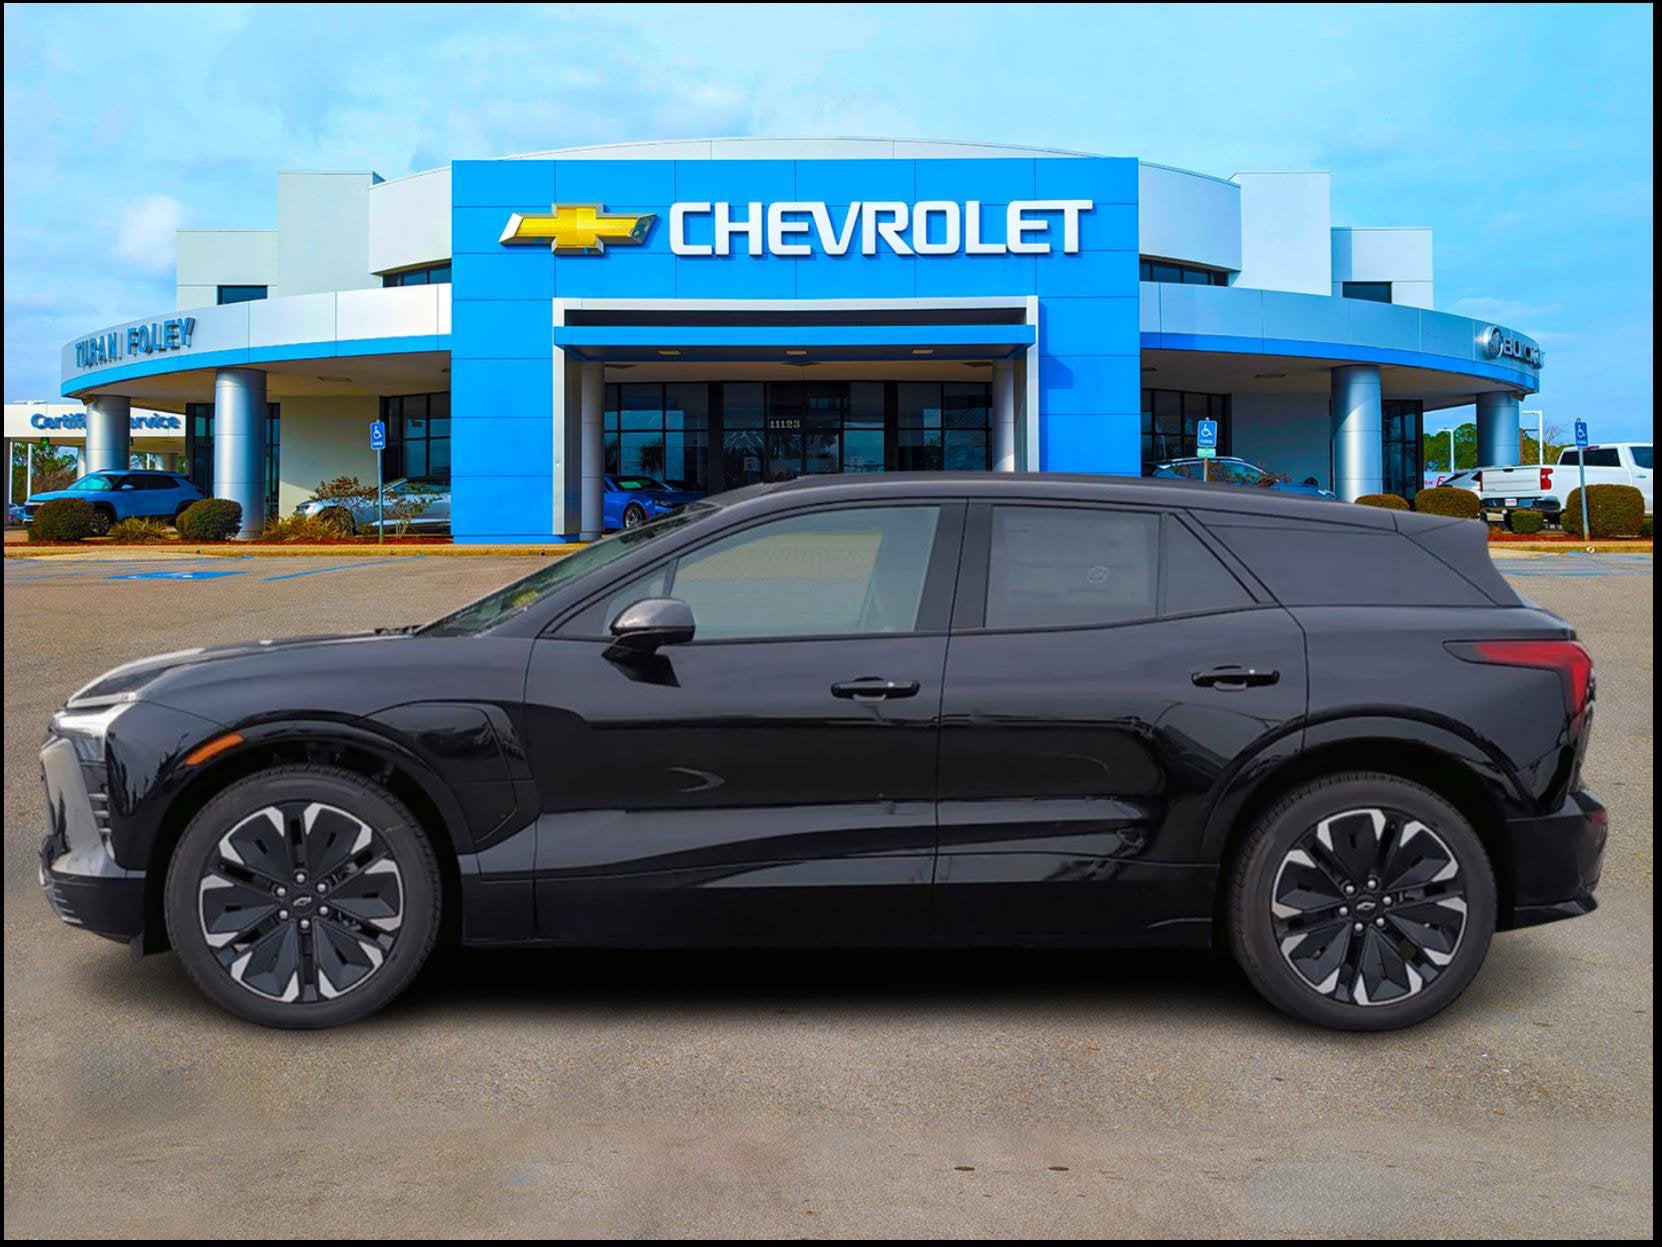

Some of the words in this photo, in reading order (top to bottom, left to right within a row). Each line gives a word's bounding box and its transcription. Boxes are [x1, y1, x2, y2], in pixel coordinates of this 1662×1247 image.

[669, 200, 1093, 256] CHEVROLET
[75, 332, 121, 368] TURAN
[127, 318, 196, 356] FOLEY
[31, 413, 87, 430] Certifi
[129, 412, 182, 430] ervice
[769, 419, 801, 429] 11123
